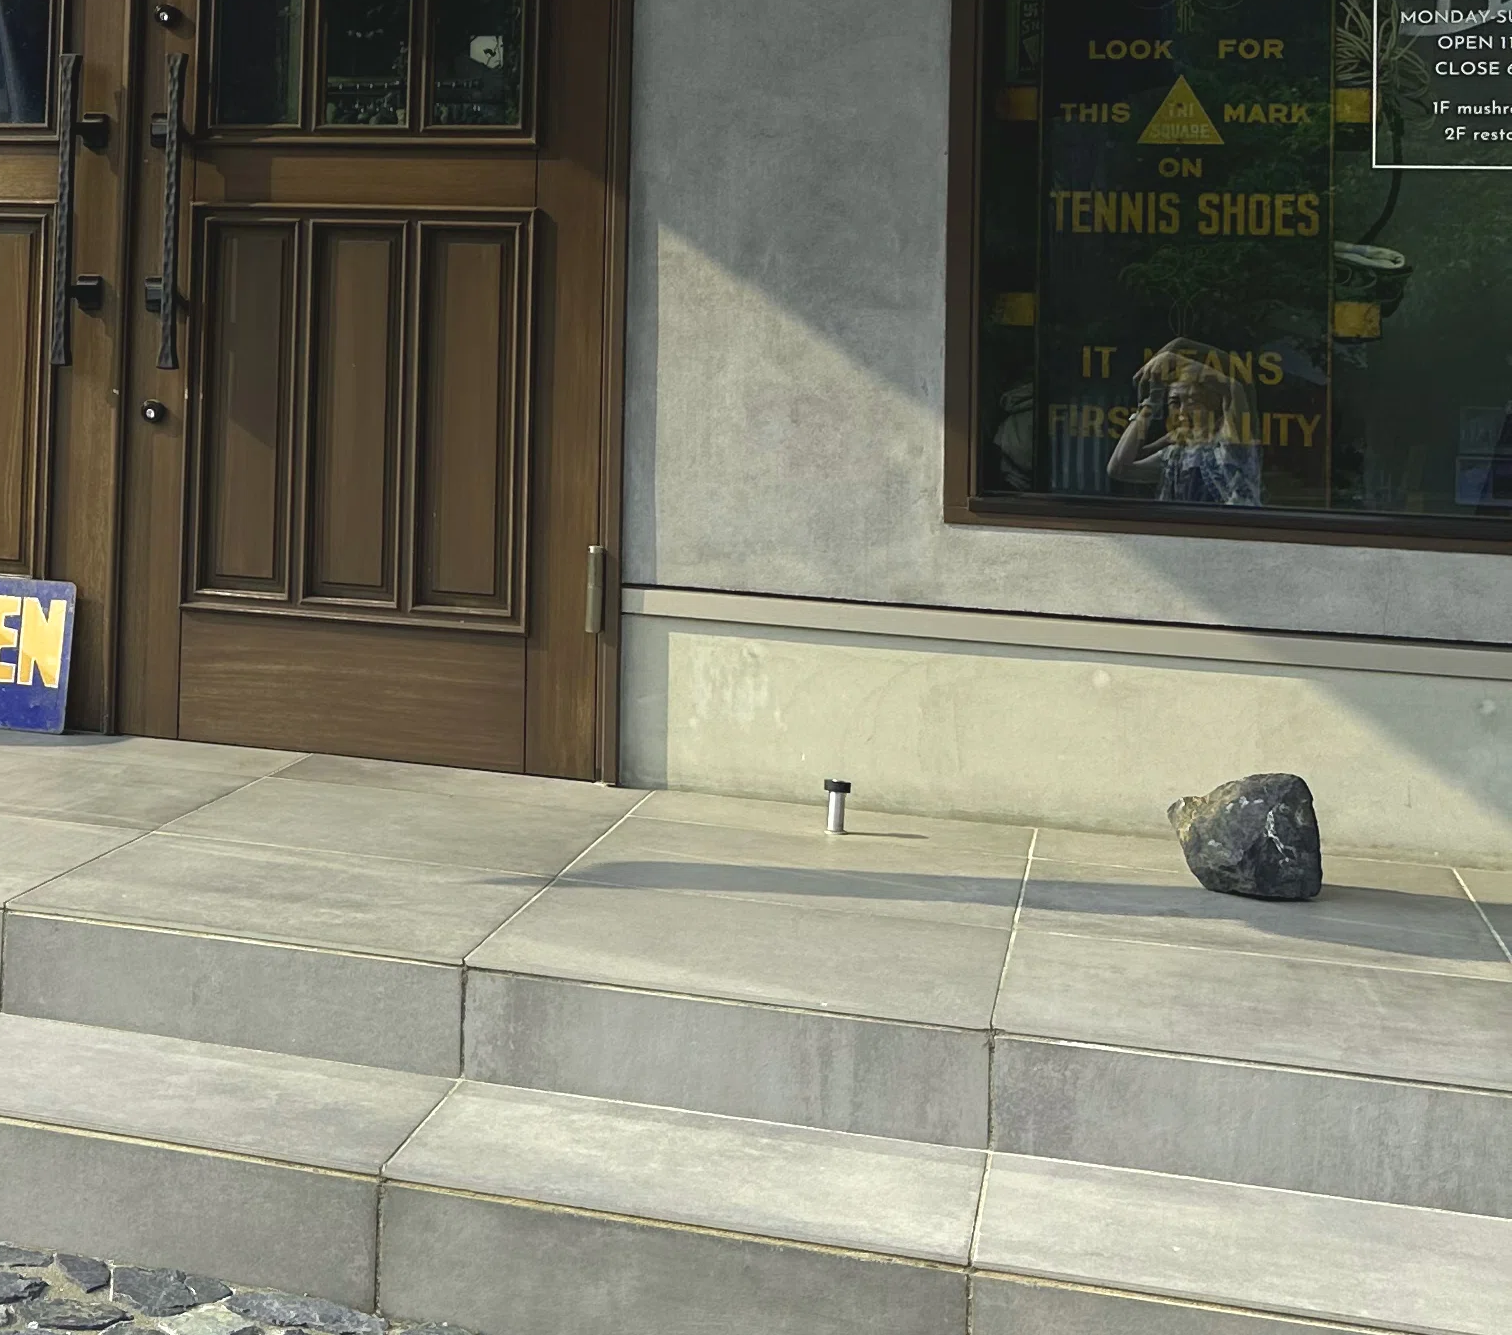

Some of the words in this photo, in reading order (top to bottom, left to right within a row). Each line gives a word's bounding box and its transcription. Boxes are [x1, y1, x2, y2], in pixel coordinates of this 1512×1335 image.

[1088, 39, 1173, 60] LOOK
[1218, 38, 1285, 60] FOR
[1437, 35, 1494, 50] OPEN
[1435, 61, 1500, 76] CLOSE
[1059, 102, 1132, 124] THIS
[1223, 103, 1311, 124] MARK
[1167, 102, 1195, 118] TRI
[1433, 100, 1451, 115] 1F
[1457, 99, 1512, 115] mushr
[1148, 122, 1211, 139] SQUARE
[1444, 126, 1467, 141] 2F
[1157, 157, 1203, 178] ON
[1049, 190, 1180, 235] TENNIS
[1197, 192, 1320, 237] SHOES
[1081, 346, 1118, 379] IT
[1144, 348, 1284, 386] MEANS
[1048, 404, 1148, 440] FIRST
[1165, 409, 1321, 447] QUALITY
